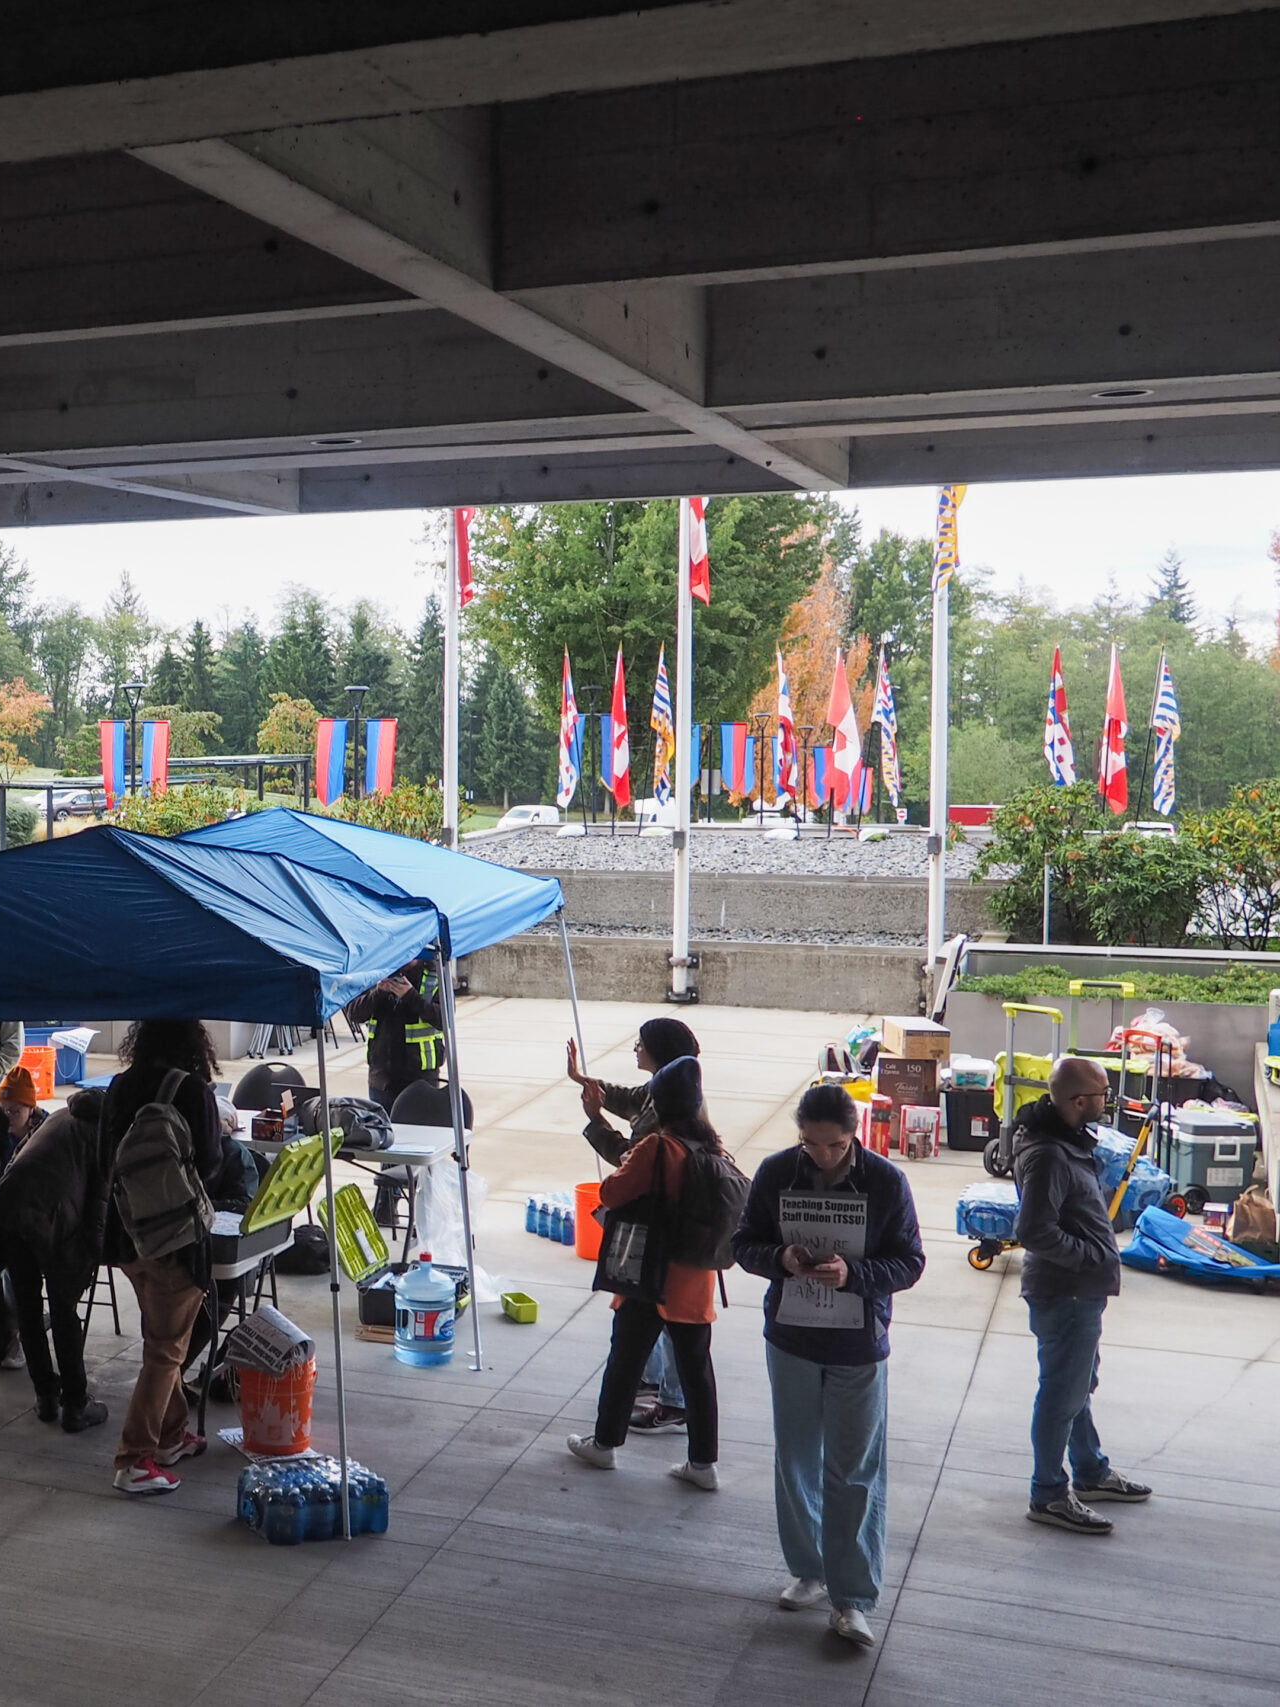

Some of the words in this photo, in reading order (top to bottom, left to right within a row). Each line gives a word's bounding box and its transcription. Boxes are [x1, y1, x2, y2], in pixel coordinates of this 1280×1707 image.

[906, 1064, 922, 1073] 150
[782, 1199, 823, 1211] Teaching
[824, 1200, 864, 1213] Support
[782, 1212, 802, 1222] Staff
[803, 1212, 831, 1223] Union
[833, 1214, 865, 1226] (TSSU)
